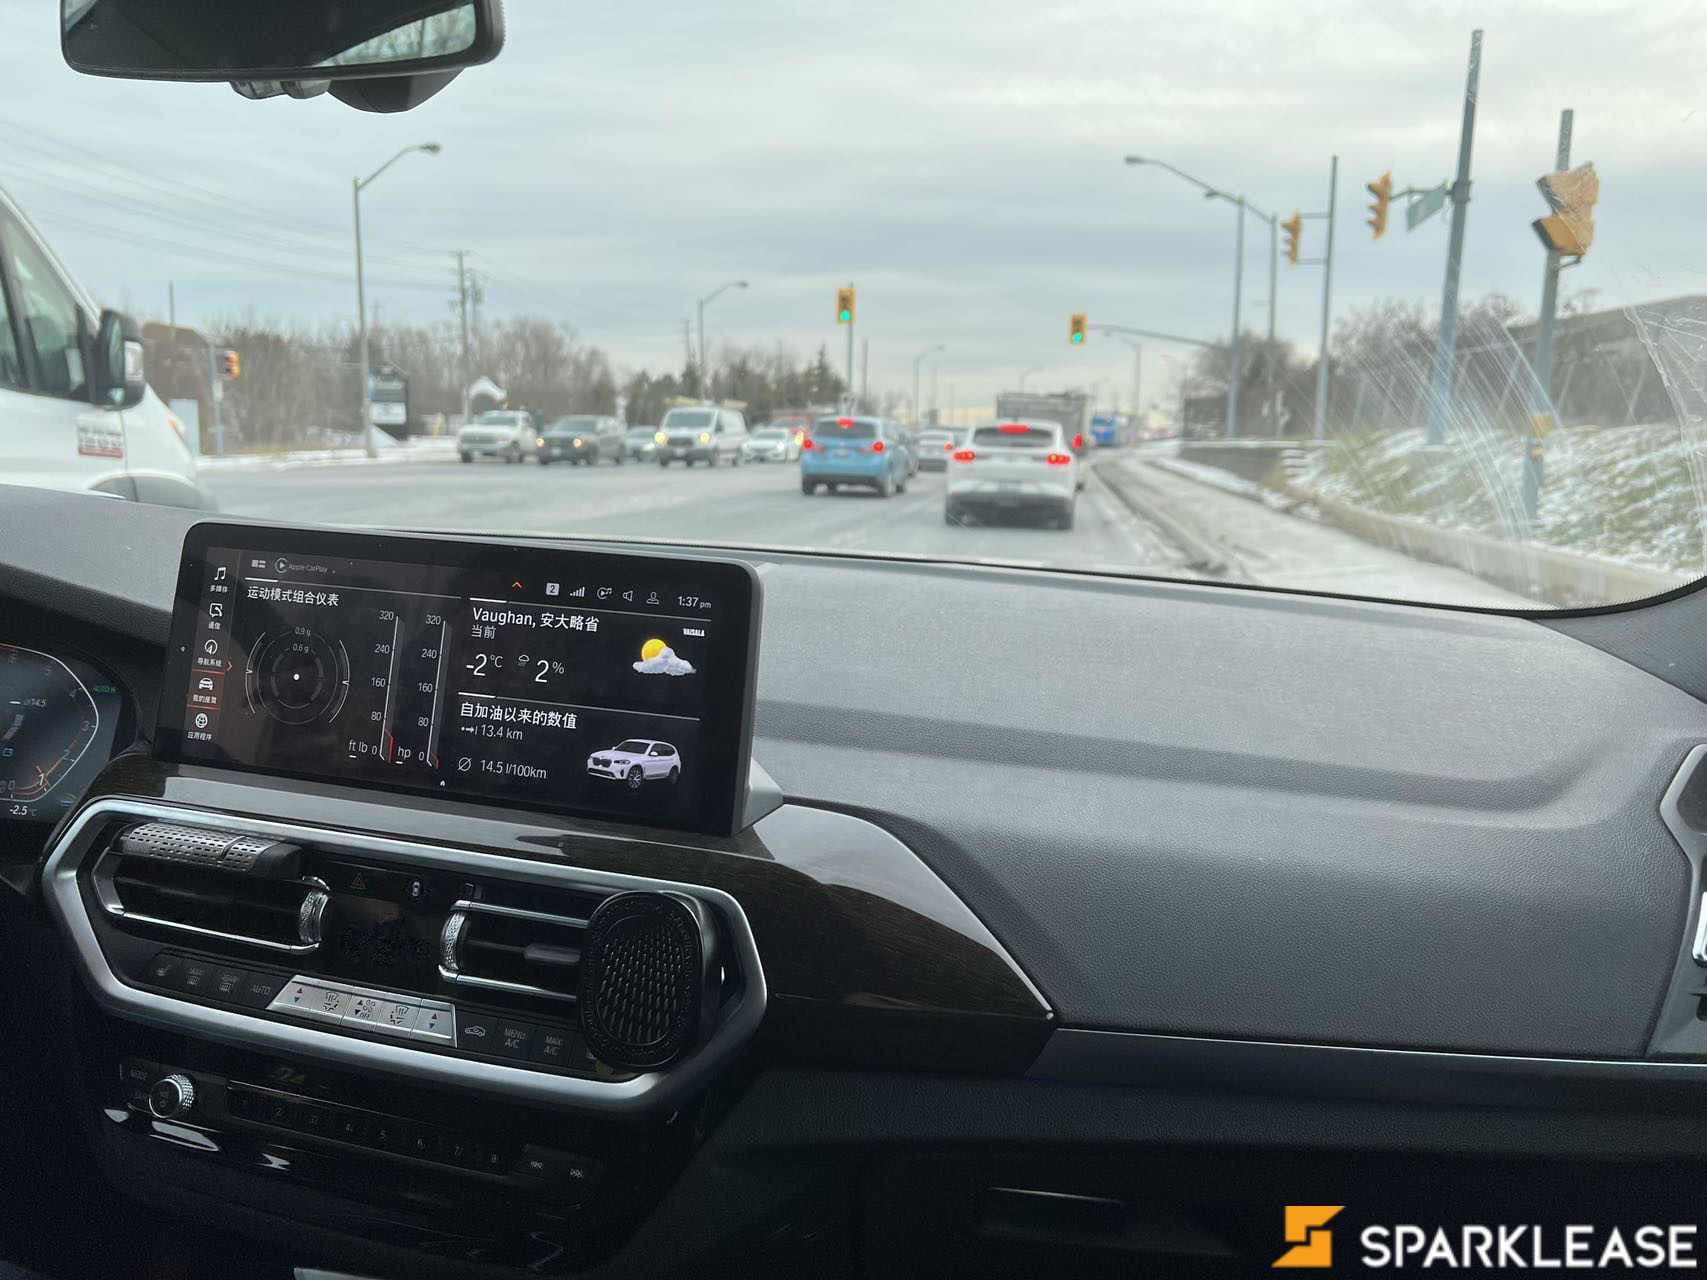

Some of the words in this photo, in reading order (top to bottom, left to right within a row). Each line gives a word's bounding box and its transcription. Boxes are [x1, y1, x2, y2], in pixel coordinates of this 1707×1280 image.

[247, 586, 340, 606] 运动模式组合仪表
[678, 596, 699, 607] 1:37
[699, 601, 712, 609] pm
[379, 610, 394, 621] 320
[425, 615, 441, 625] 320
[473, 607, 537, 628] Vaughan,
[540, 612, 600, 632] 安大略省
[471, 624, 497, 639] 当前
[374, 644, 390, 654] 240
[421, 649, 437, 659] 240
[371, 677, 386, 688] 160
[418, 682, 433, 693] 160
[370, 711, 382, 721] 80
[460, 701, 578, 730] 自加油以来的数值
[418, 717, 429, 727] 80
[481, 724, 504, 738] 13.4
[506, 727, 523, 740] km
[371, 745, 378, 755] 0
[398, 745, 411, 759] hp
[418, 751, 425, 761] 0
[480, 760, 504, 775] 14.5
[505, 763, 547, 779] l/100km
[10, 804, 28, 816] -2.5
